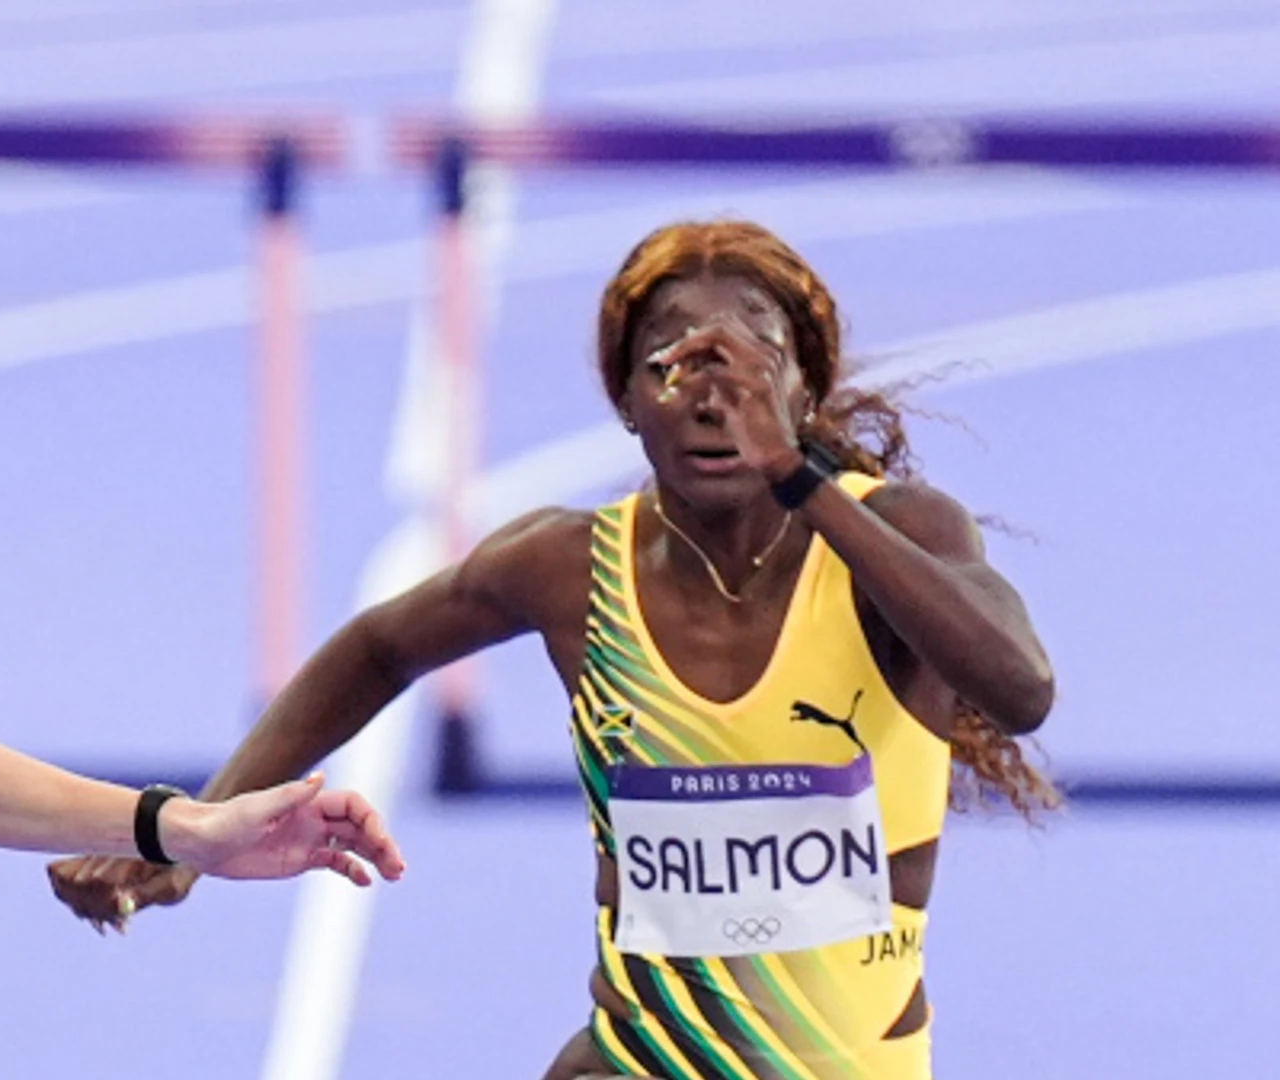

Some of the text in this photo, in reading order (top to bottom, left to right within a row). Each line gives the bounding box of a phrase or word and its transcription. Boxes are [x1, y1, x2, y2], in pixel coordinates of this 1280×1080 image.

[748, 771, 811, 791] 2024
[627, 823, 878, 894] SALMON
[859, 927, 923, 966] JAM
